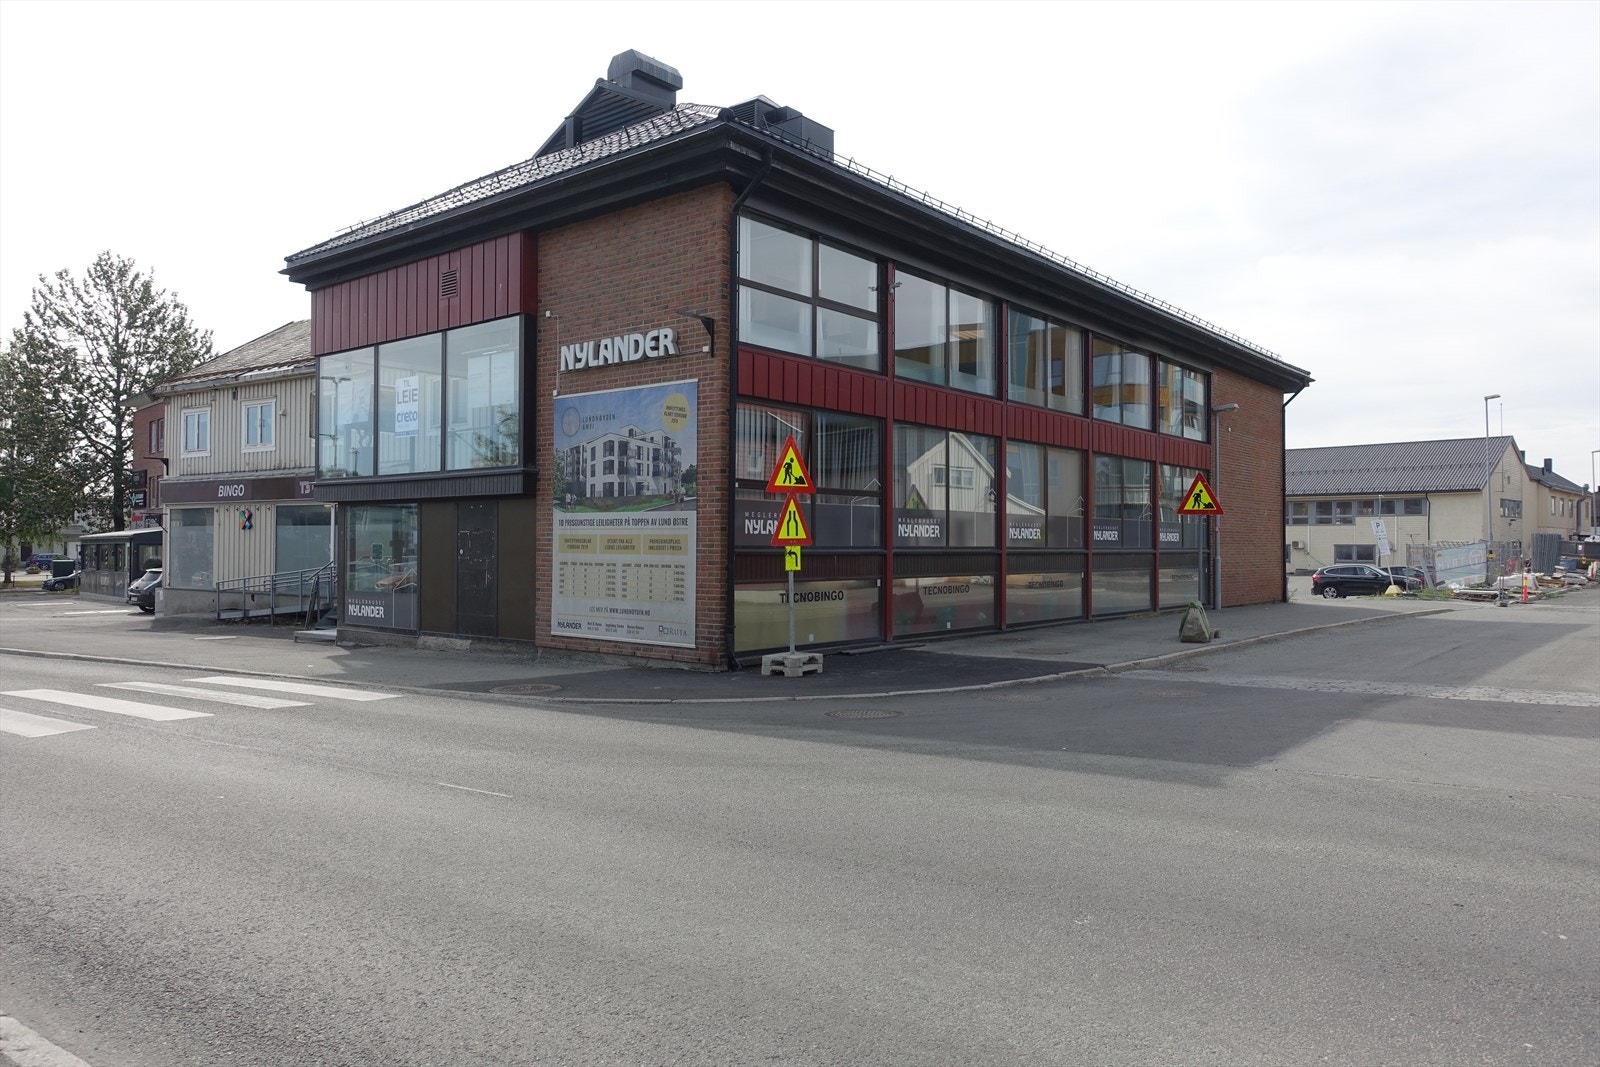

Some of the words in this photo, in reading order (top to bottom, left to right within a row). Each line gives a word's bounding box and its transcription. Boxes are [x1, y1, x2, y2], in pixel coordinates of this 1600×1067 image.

[560, 327, 677, 371] NYLANDER
[396, 388, 418, 405] LEIE
[396, 410, 418, 423] creto
[218, 484, 245, 497] BINGO
[632, 518, 650, 527] TOPPEN
[650, 518, 658, 526] AV
[658, 517, 672, 526] LUND
[745, 519, 779, 535] NYLA
[898, 524, 940, 538] NYLANDER
[1009, 527, 1041, 539] NYLANDER
[1093, 530, 1119, 541] NYLANDER
[923, 585, 970, 596] TECNOBINGO
[348, 604, 385, 618] NYLANDER
[669, 627, 688, 637] RUTA
